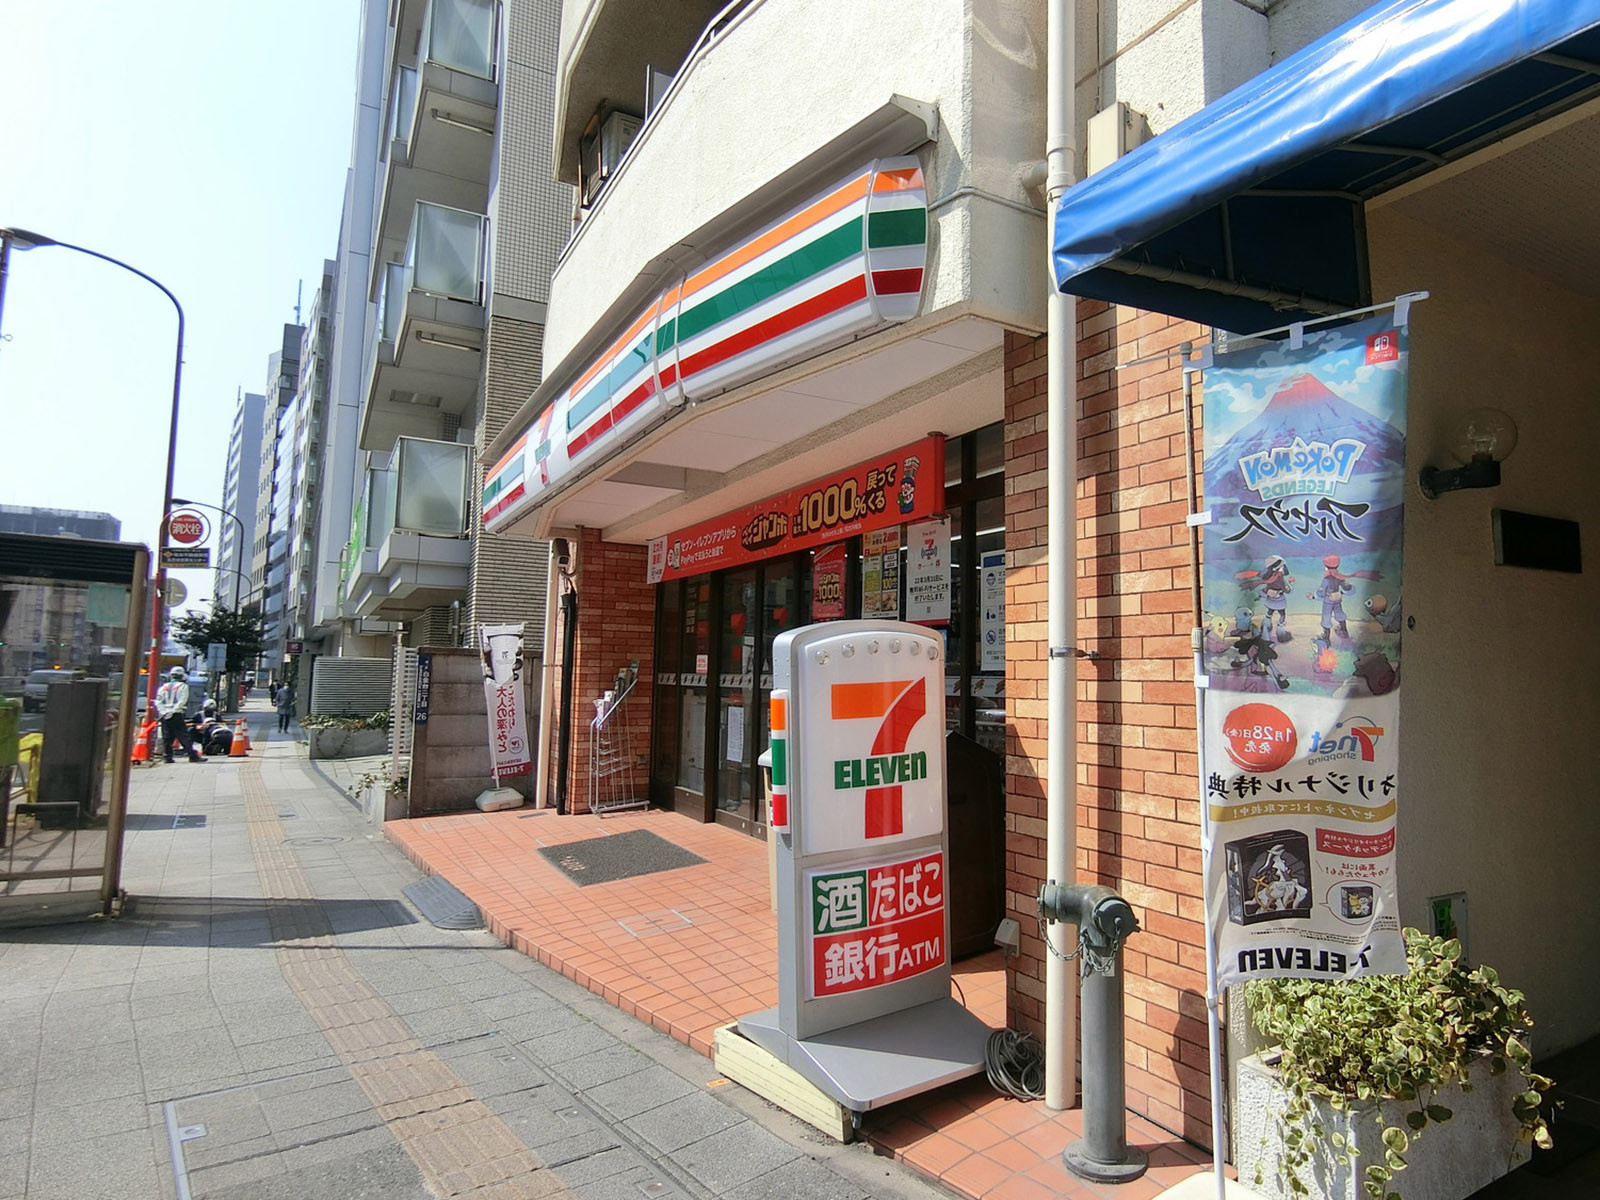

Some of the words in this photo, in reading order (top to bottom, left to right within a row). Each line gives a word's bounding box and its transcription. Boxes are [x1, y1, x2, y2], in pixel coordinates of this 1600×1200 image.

[866, 464, 897, 491] 戻って
[800, 479, 867, 532] 1000%
[867, 490, 886, 511] くる
[172, 522, 201, 536] 消火栓
[416, 712, 427, 720] 26
[831, 676, 926, 839] 7
[817, 874, 865, 932] 酒
[871, 862, 942, 923] たばこ
[824, 932, 940, 987] 銀行ATM
